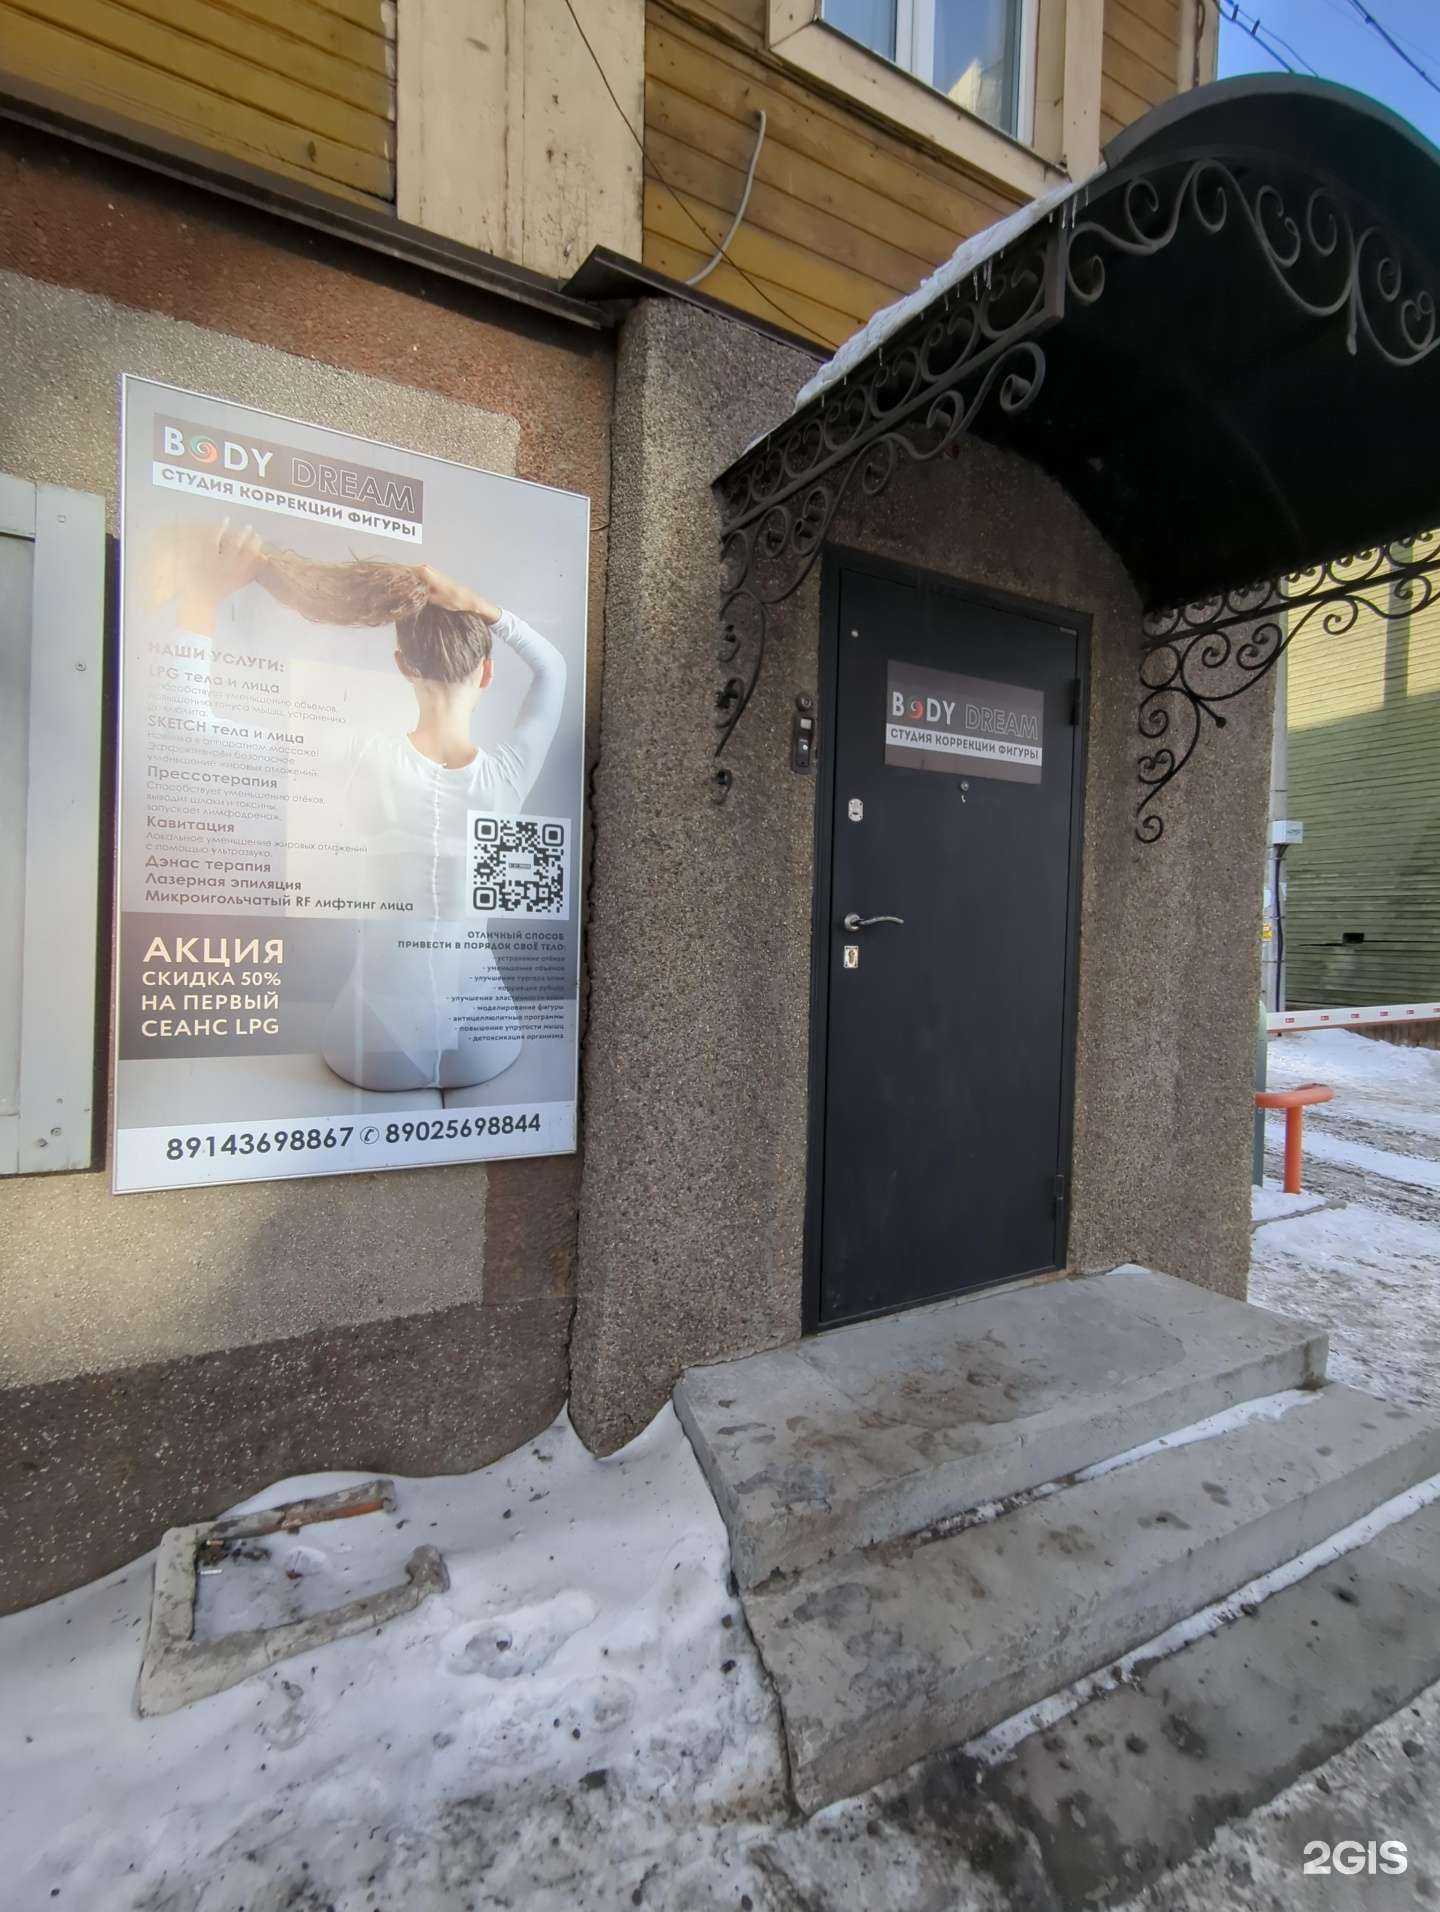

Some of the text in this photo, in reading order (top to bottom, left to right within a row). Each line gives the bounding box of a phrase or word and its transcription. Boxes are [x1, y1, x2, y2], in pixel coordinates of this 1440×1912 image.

[164, 426, 416, 513] BODY DREAM
[161, 468, 416, 537] СТУДИЯ КОРРЕКЦИИ ФИГУРЫ
[148, 641, 285, 673] НАШИ УСЛУГИ:
[150, 664, 280, 694] LPG тела и лица
[892, 691, 1039, 740] BODY DREAM
[147, 714, 305, 745] SKETCH тела и лица
[890, 727, 1039, 760] СТУДИЯ КОРРЕКЦИИ ФИГУРЫ
[147, 765, 278, 789] Прессотерапия
[147, 815, 235, 833] Кавитация
[145, 855, 271, 873] Дэнас терапия
[145, 872, 302, 891] Лазерная эпиляция
[145, 889, 414, 912] Микроигольчатый RF лифтинг лица
[398, 940, 452, 949] ПРИВЕСТИ
[455, 941, 461, 949] В
[464, 941, 511, 951] ПОРЯДОК
[467, 930, 565, 941] ОТЛИЧНЫЙ СПОСОБ
[142, 936, 284, 968] АКЦИЯ
[142, 971, 282, 988] СКИДКА 50%
[141, 990, 280, 1011] НА ПЕРВЫЙ
[141, 1017, 280, 1038] СЕАНС LPG
[166, 1112, 542, 1161] 89143698867 89025698844
